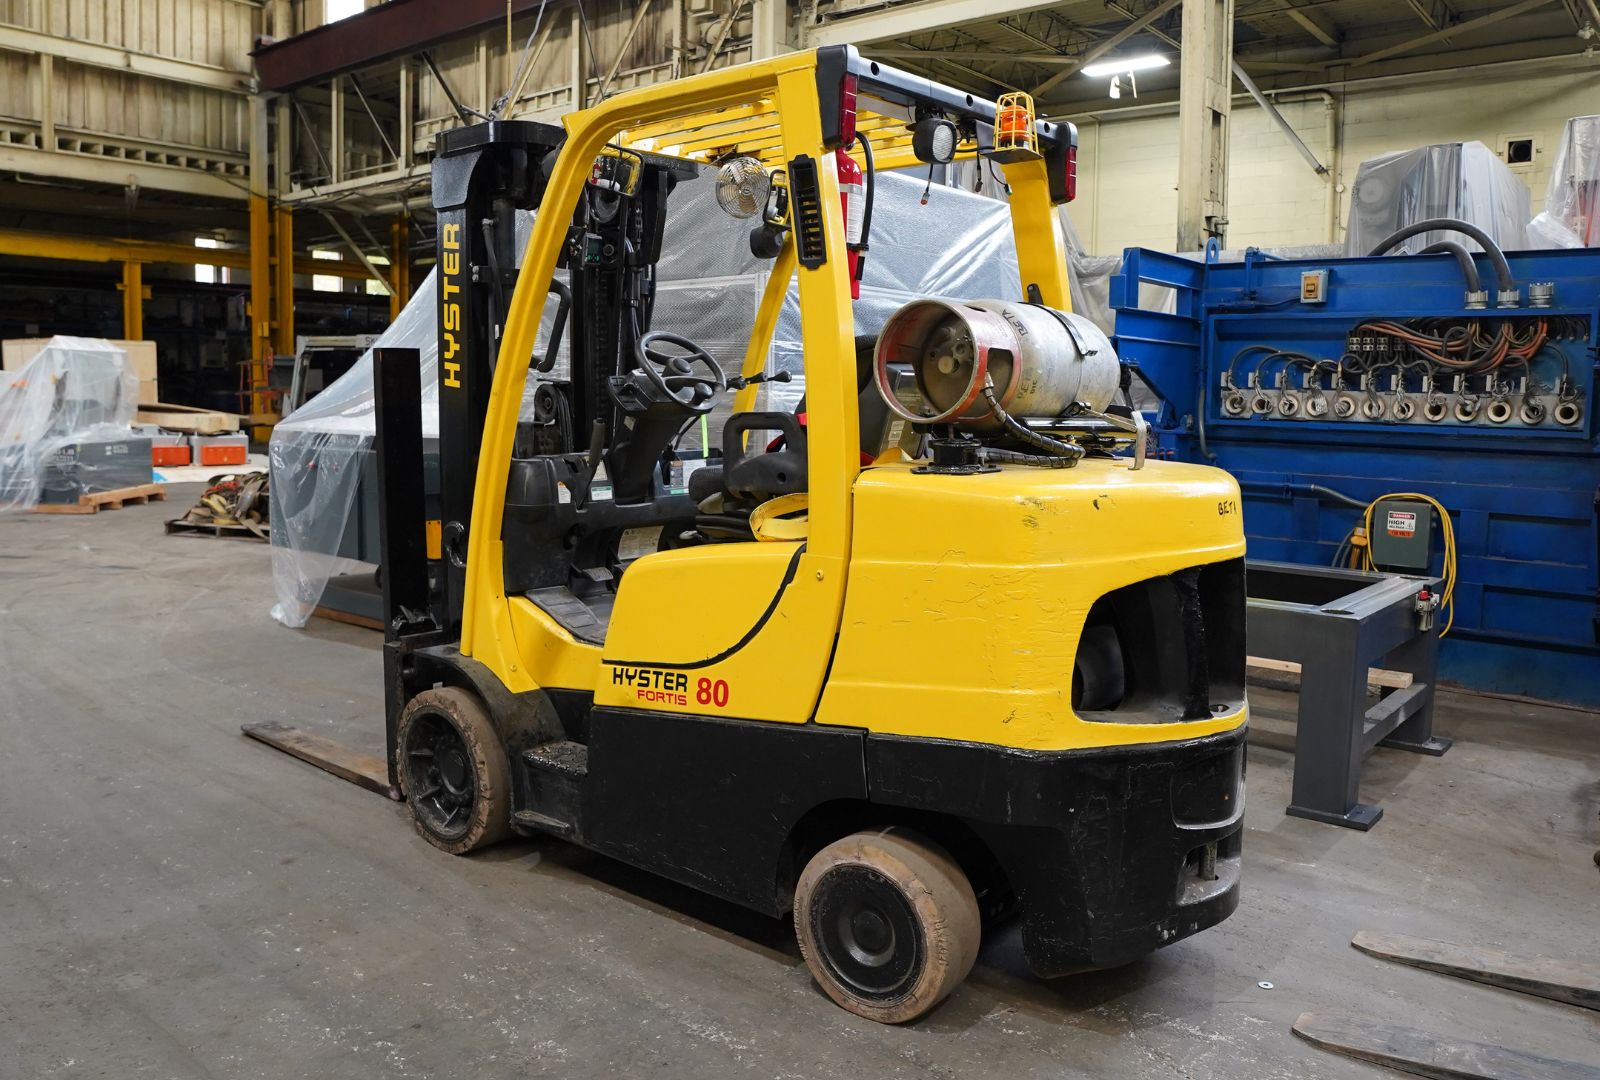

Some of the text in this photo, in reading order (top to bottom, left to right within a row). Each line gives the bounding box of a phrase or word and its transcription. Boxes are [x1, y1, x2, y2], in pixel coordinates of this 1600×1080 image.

[443, 223, 461, 388] HYSTER
[1002, 309, 1028, 336] BETA
[613, 667, 688, 693] HYSTER
[696, 677, 729, 708] 80
[637, 690, 687, 706] FORTIS
